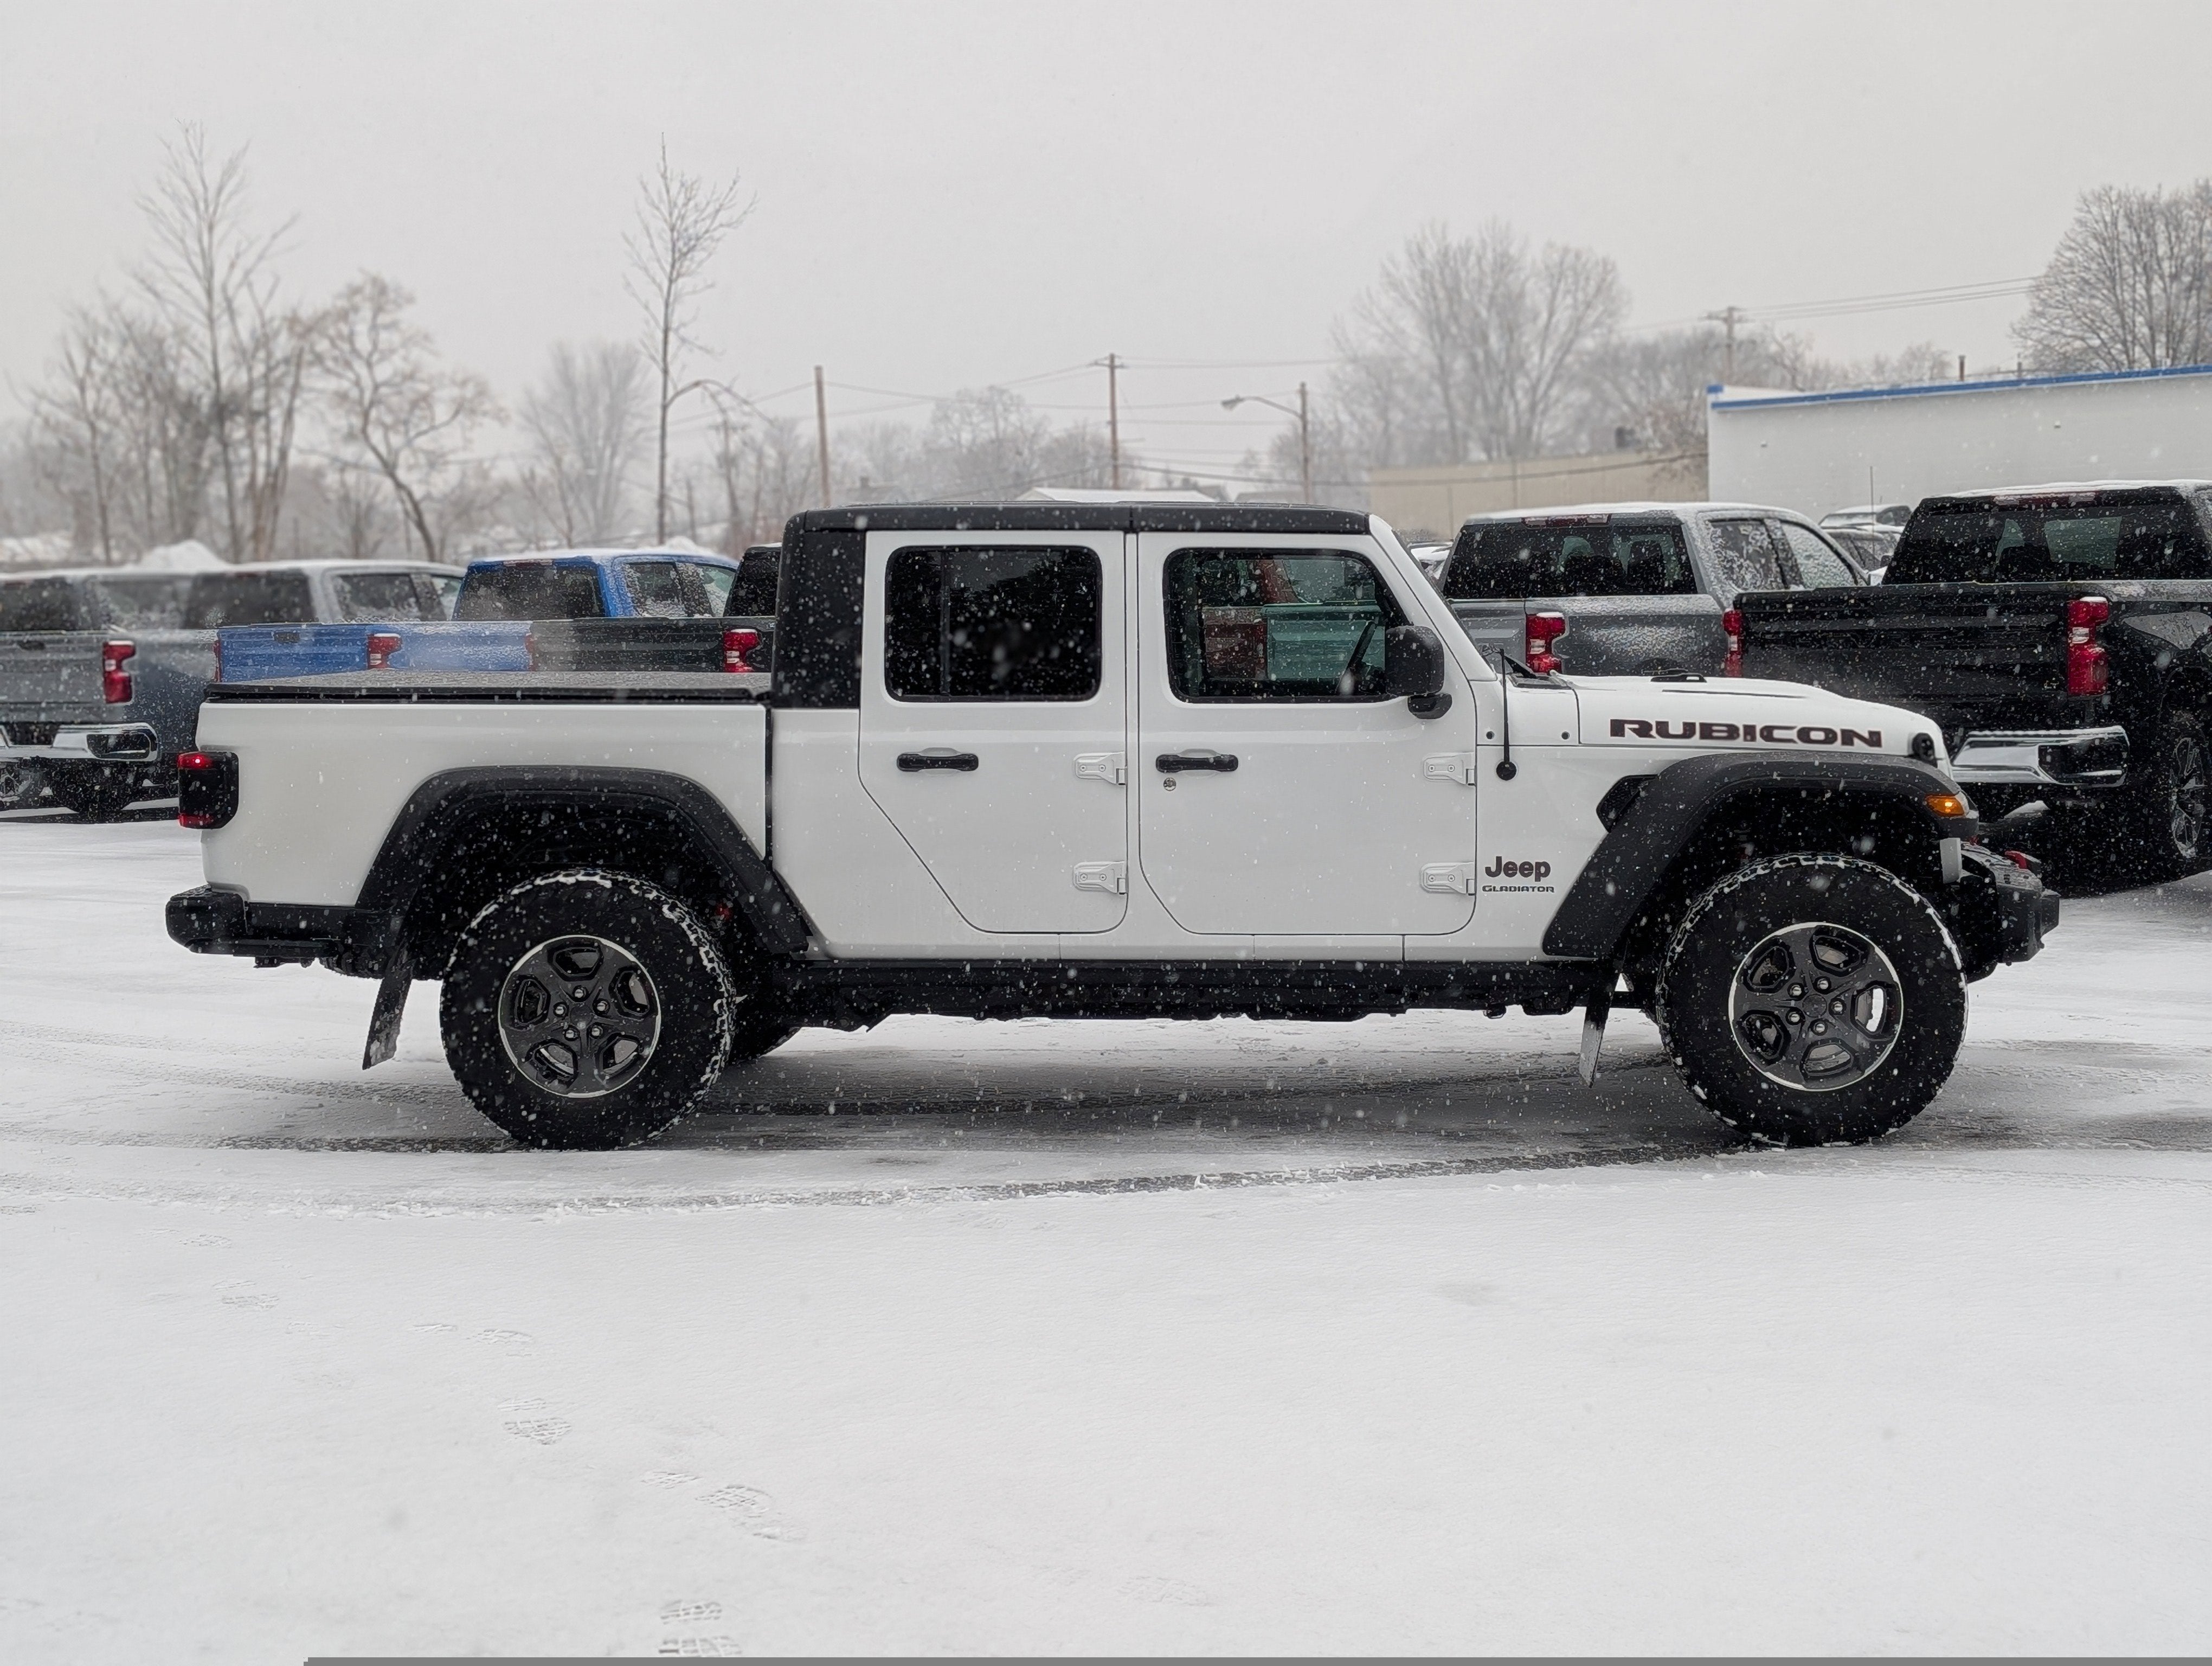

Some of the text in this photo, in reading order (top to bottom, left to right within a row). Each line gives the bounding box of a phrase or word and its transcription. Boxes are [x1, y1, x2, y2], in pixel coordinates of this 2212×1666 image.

[1610, 719, 1882, 748] RUBICON
[1485, 856, 1551, 882] Jeep
[1482, 885, 1555, 893] GLADIATOR
